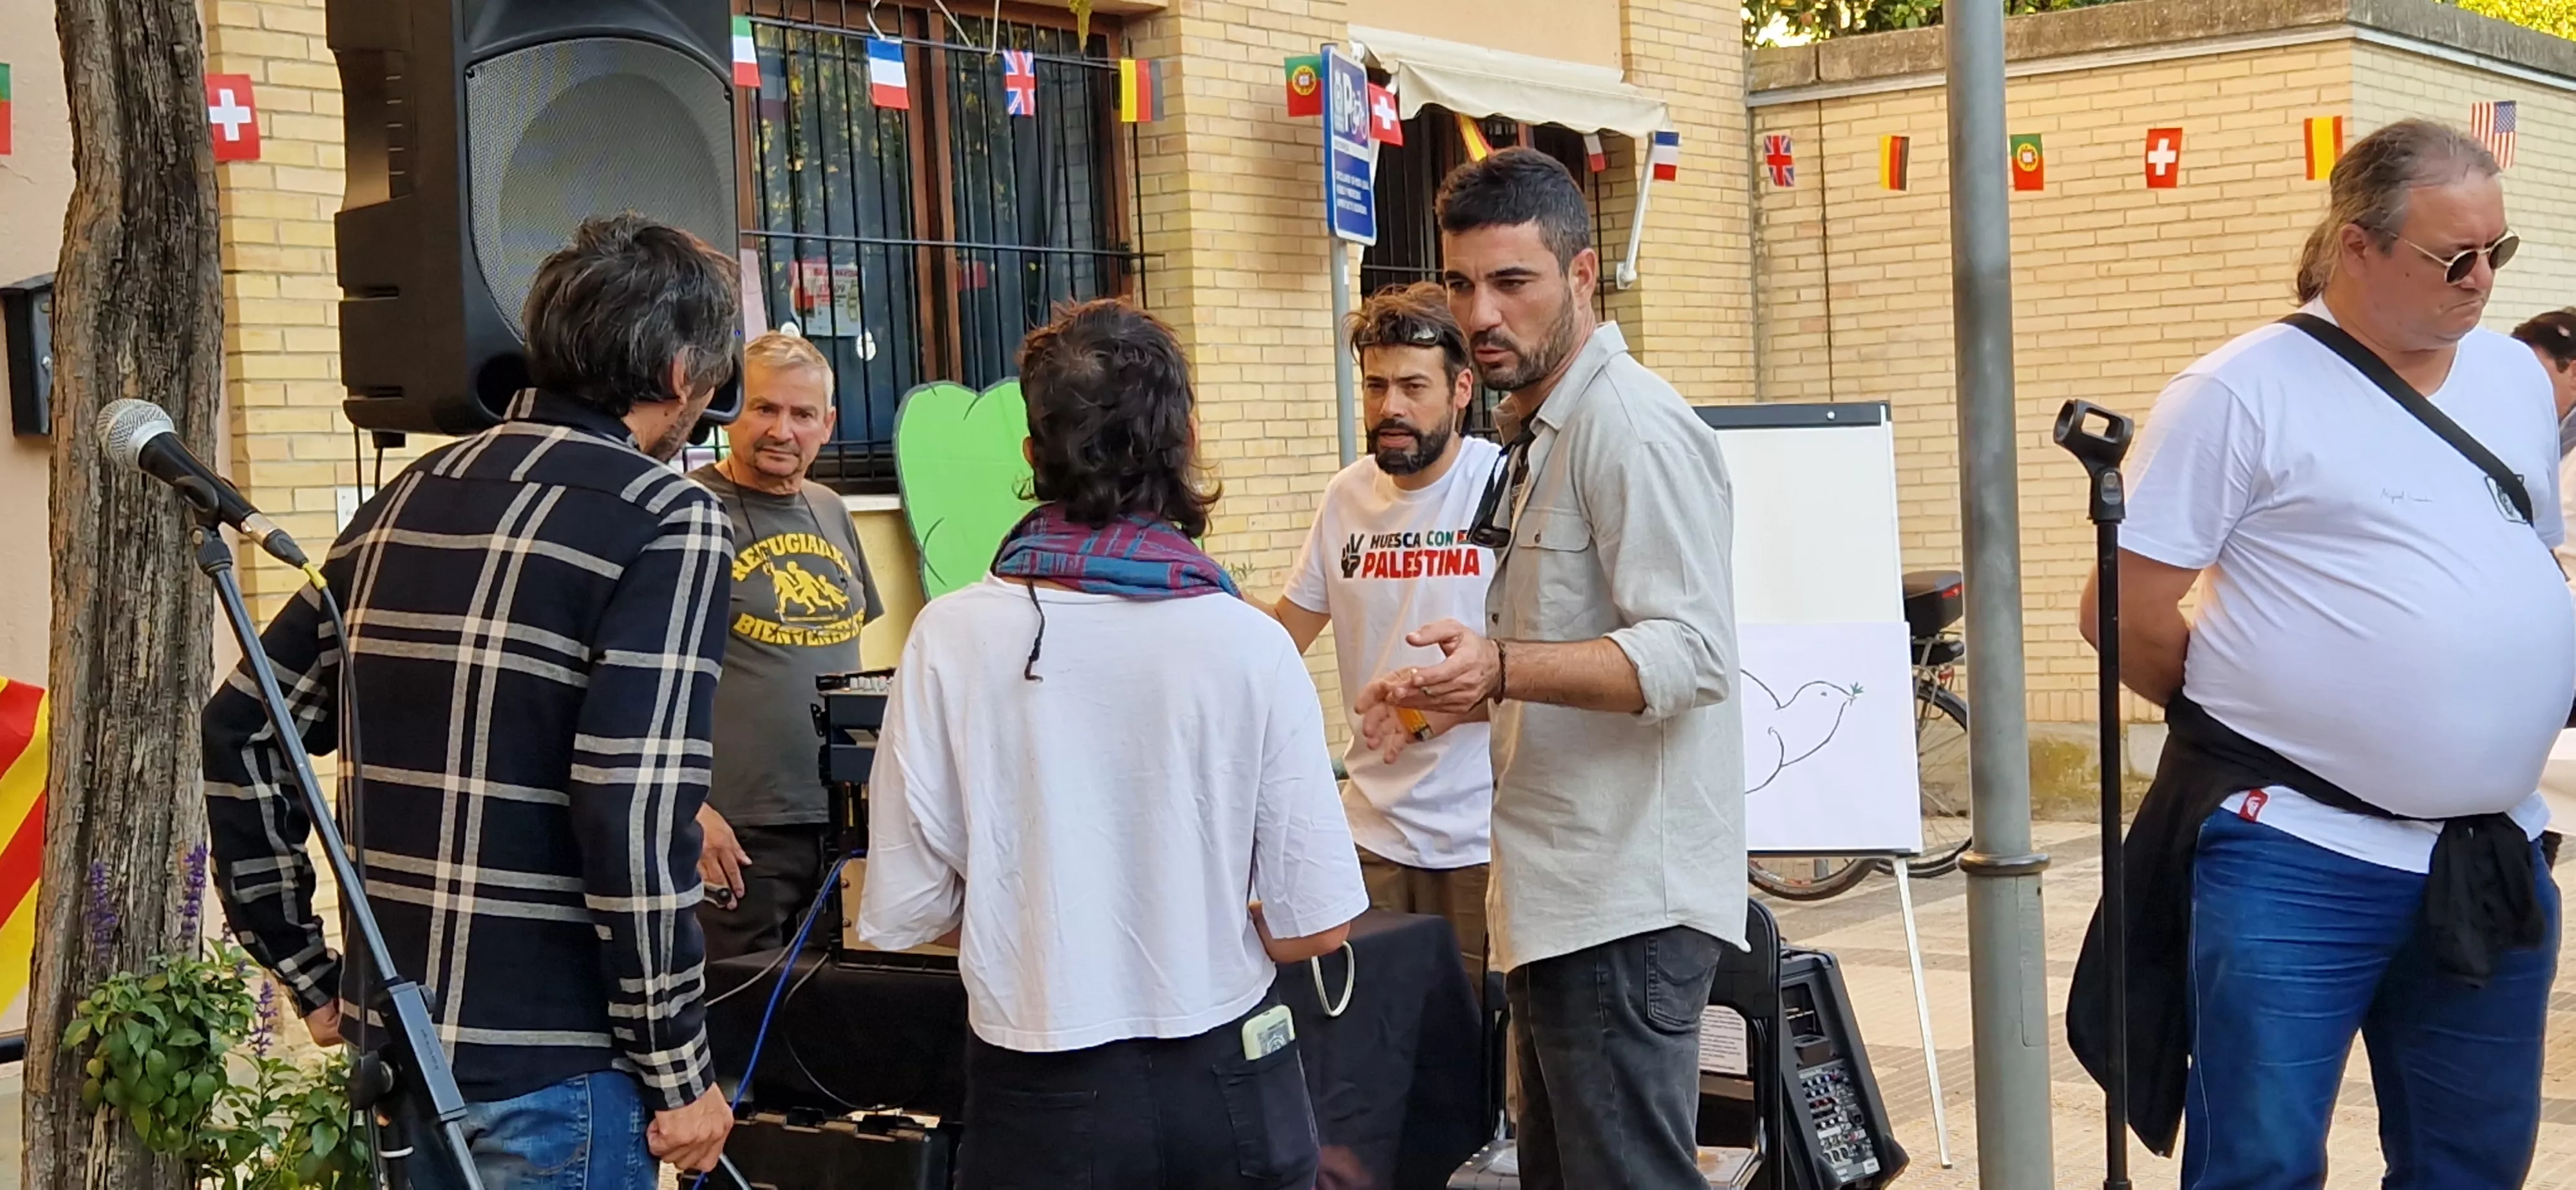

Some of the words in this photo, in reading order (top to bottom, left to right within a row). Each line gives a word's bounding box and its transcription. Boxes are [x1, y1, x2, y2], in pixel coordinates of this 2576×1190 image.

[1370, 532, 1421, 549] HUESCA
[1426, 530, 1455, 546] CON
[1361, 549, 1480, 579] PALESTINA
